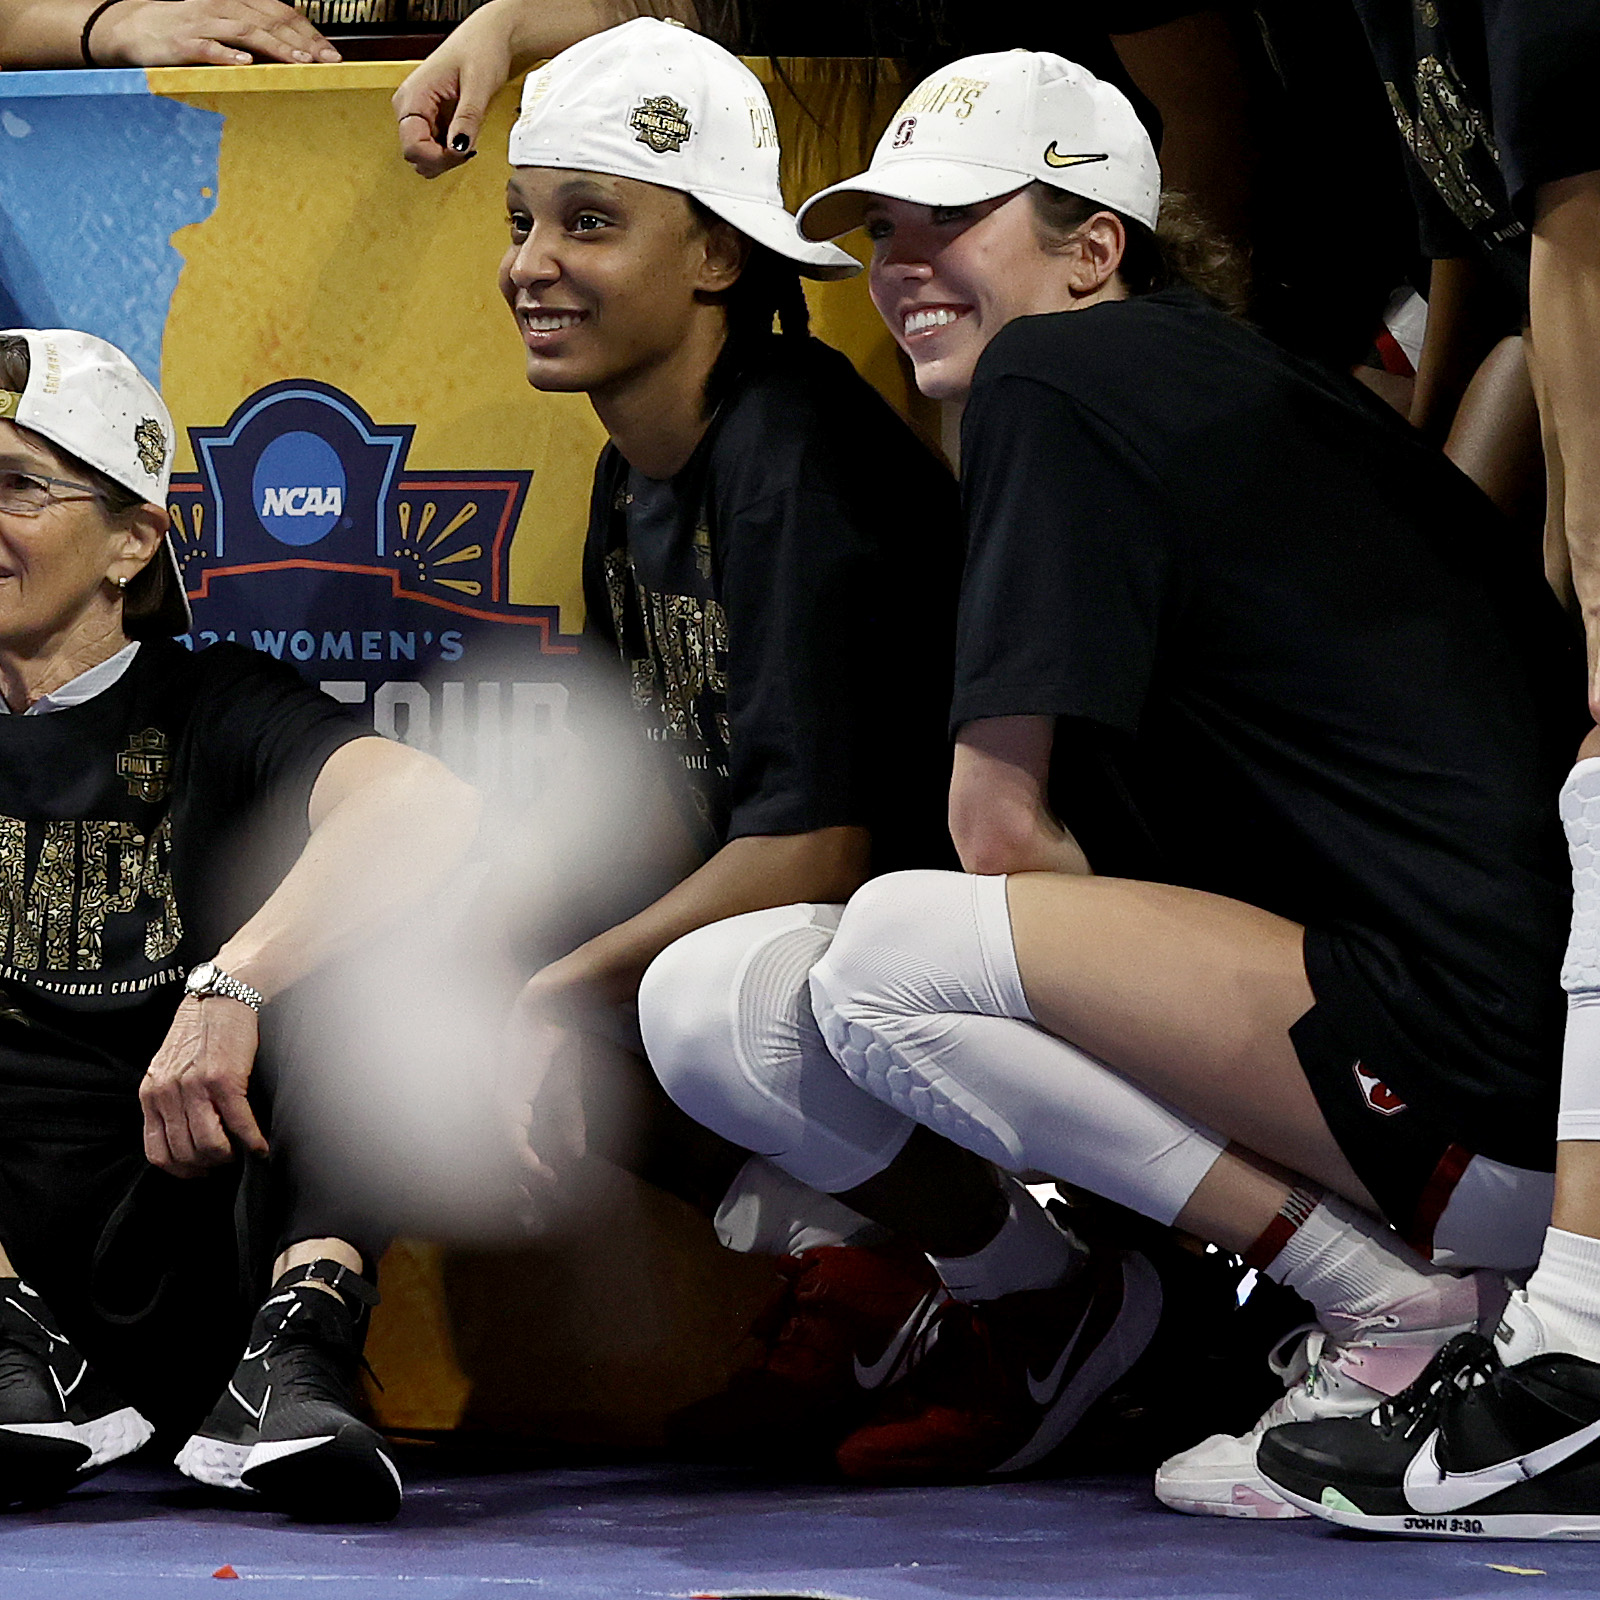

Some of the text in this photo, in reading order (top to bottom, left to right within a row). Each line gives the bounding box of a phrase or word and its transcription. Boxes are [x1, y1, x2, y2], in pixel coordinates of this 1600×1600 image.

[261, 487, 342, 517] NCAA
[251, 629, 464, 660] WOMEN'S
[111, 966, 186, 995] CHAMPIONS
[1404, 1517, 1447, 1531] JOHN
